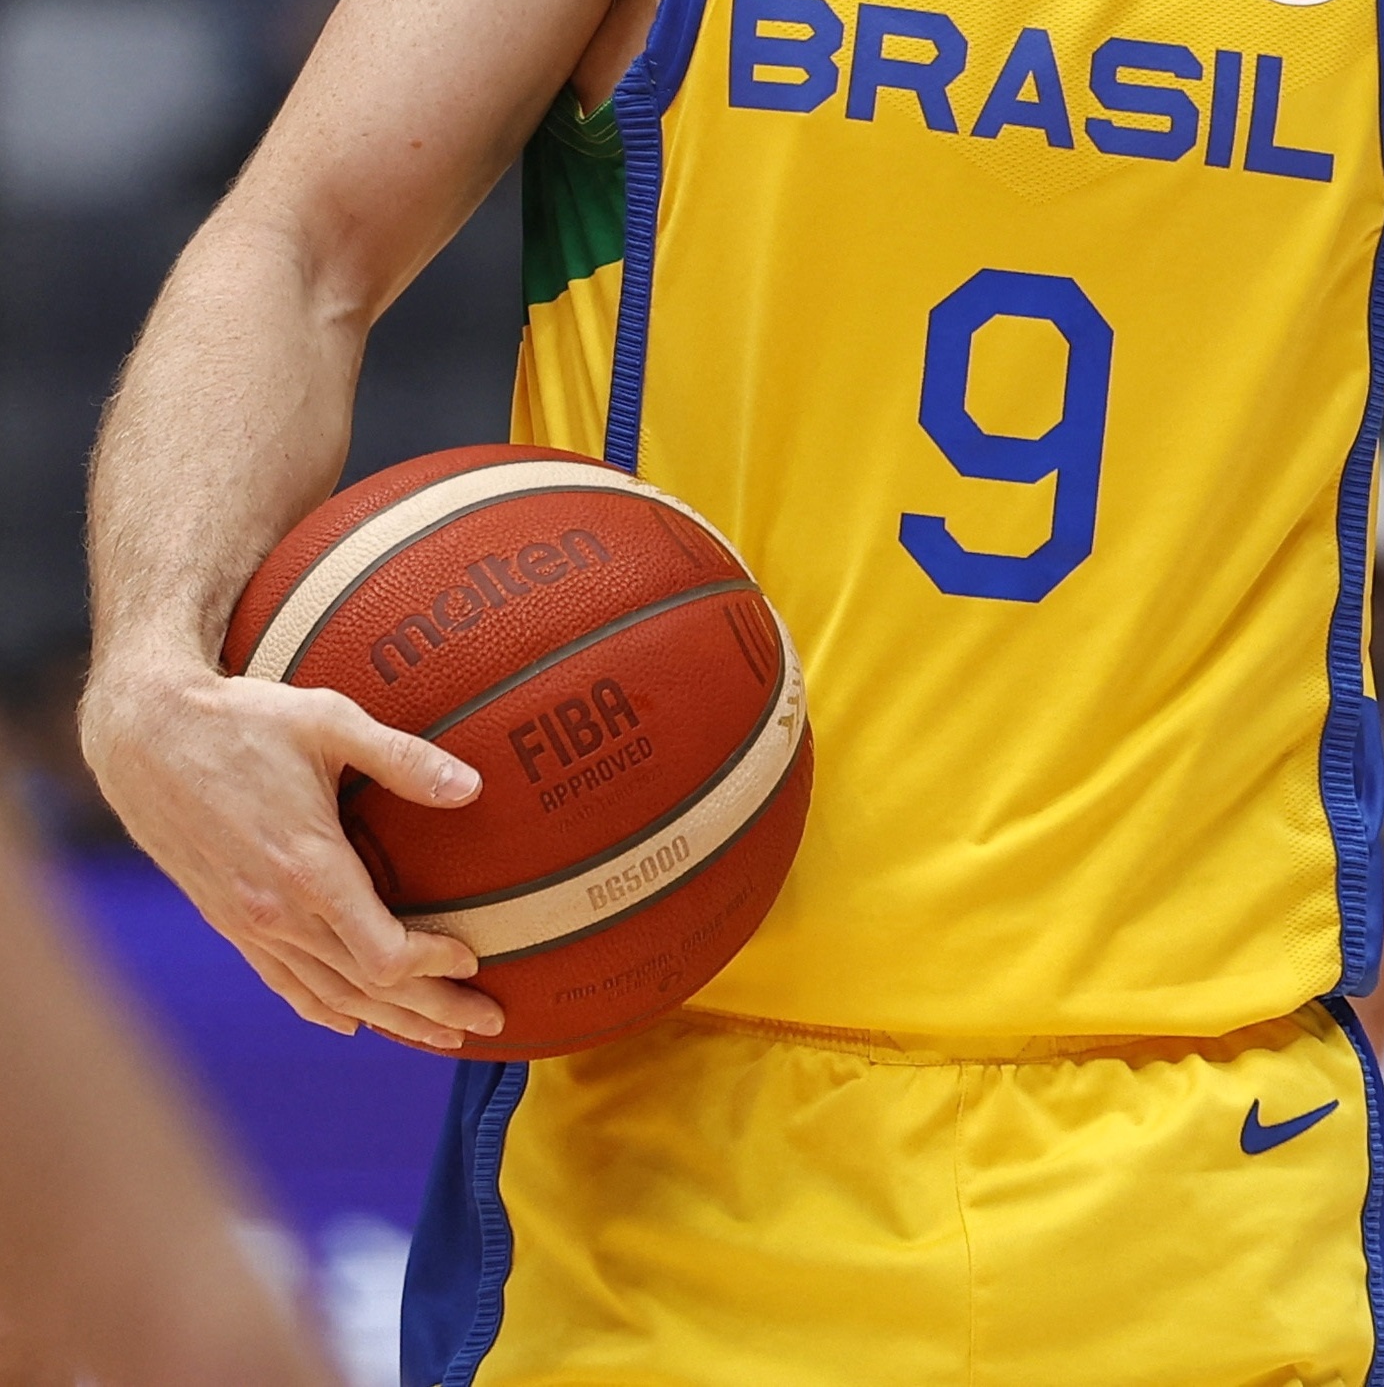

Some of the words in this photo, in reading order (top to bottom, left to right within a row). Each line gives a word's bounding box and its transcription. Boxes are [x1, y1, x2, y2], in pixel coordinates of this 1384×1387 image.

[898, 268, 1114, 603] 9
[370, 529, 612, 686] molten
[508, 678, 640, 784] FIBA
[540, 736, 653, 813] APPROVED
[586, 835, 689, 911] BG5000
